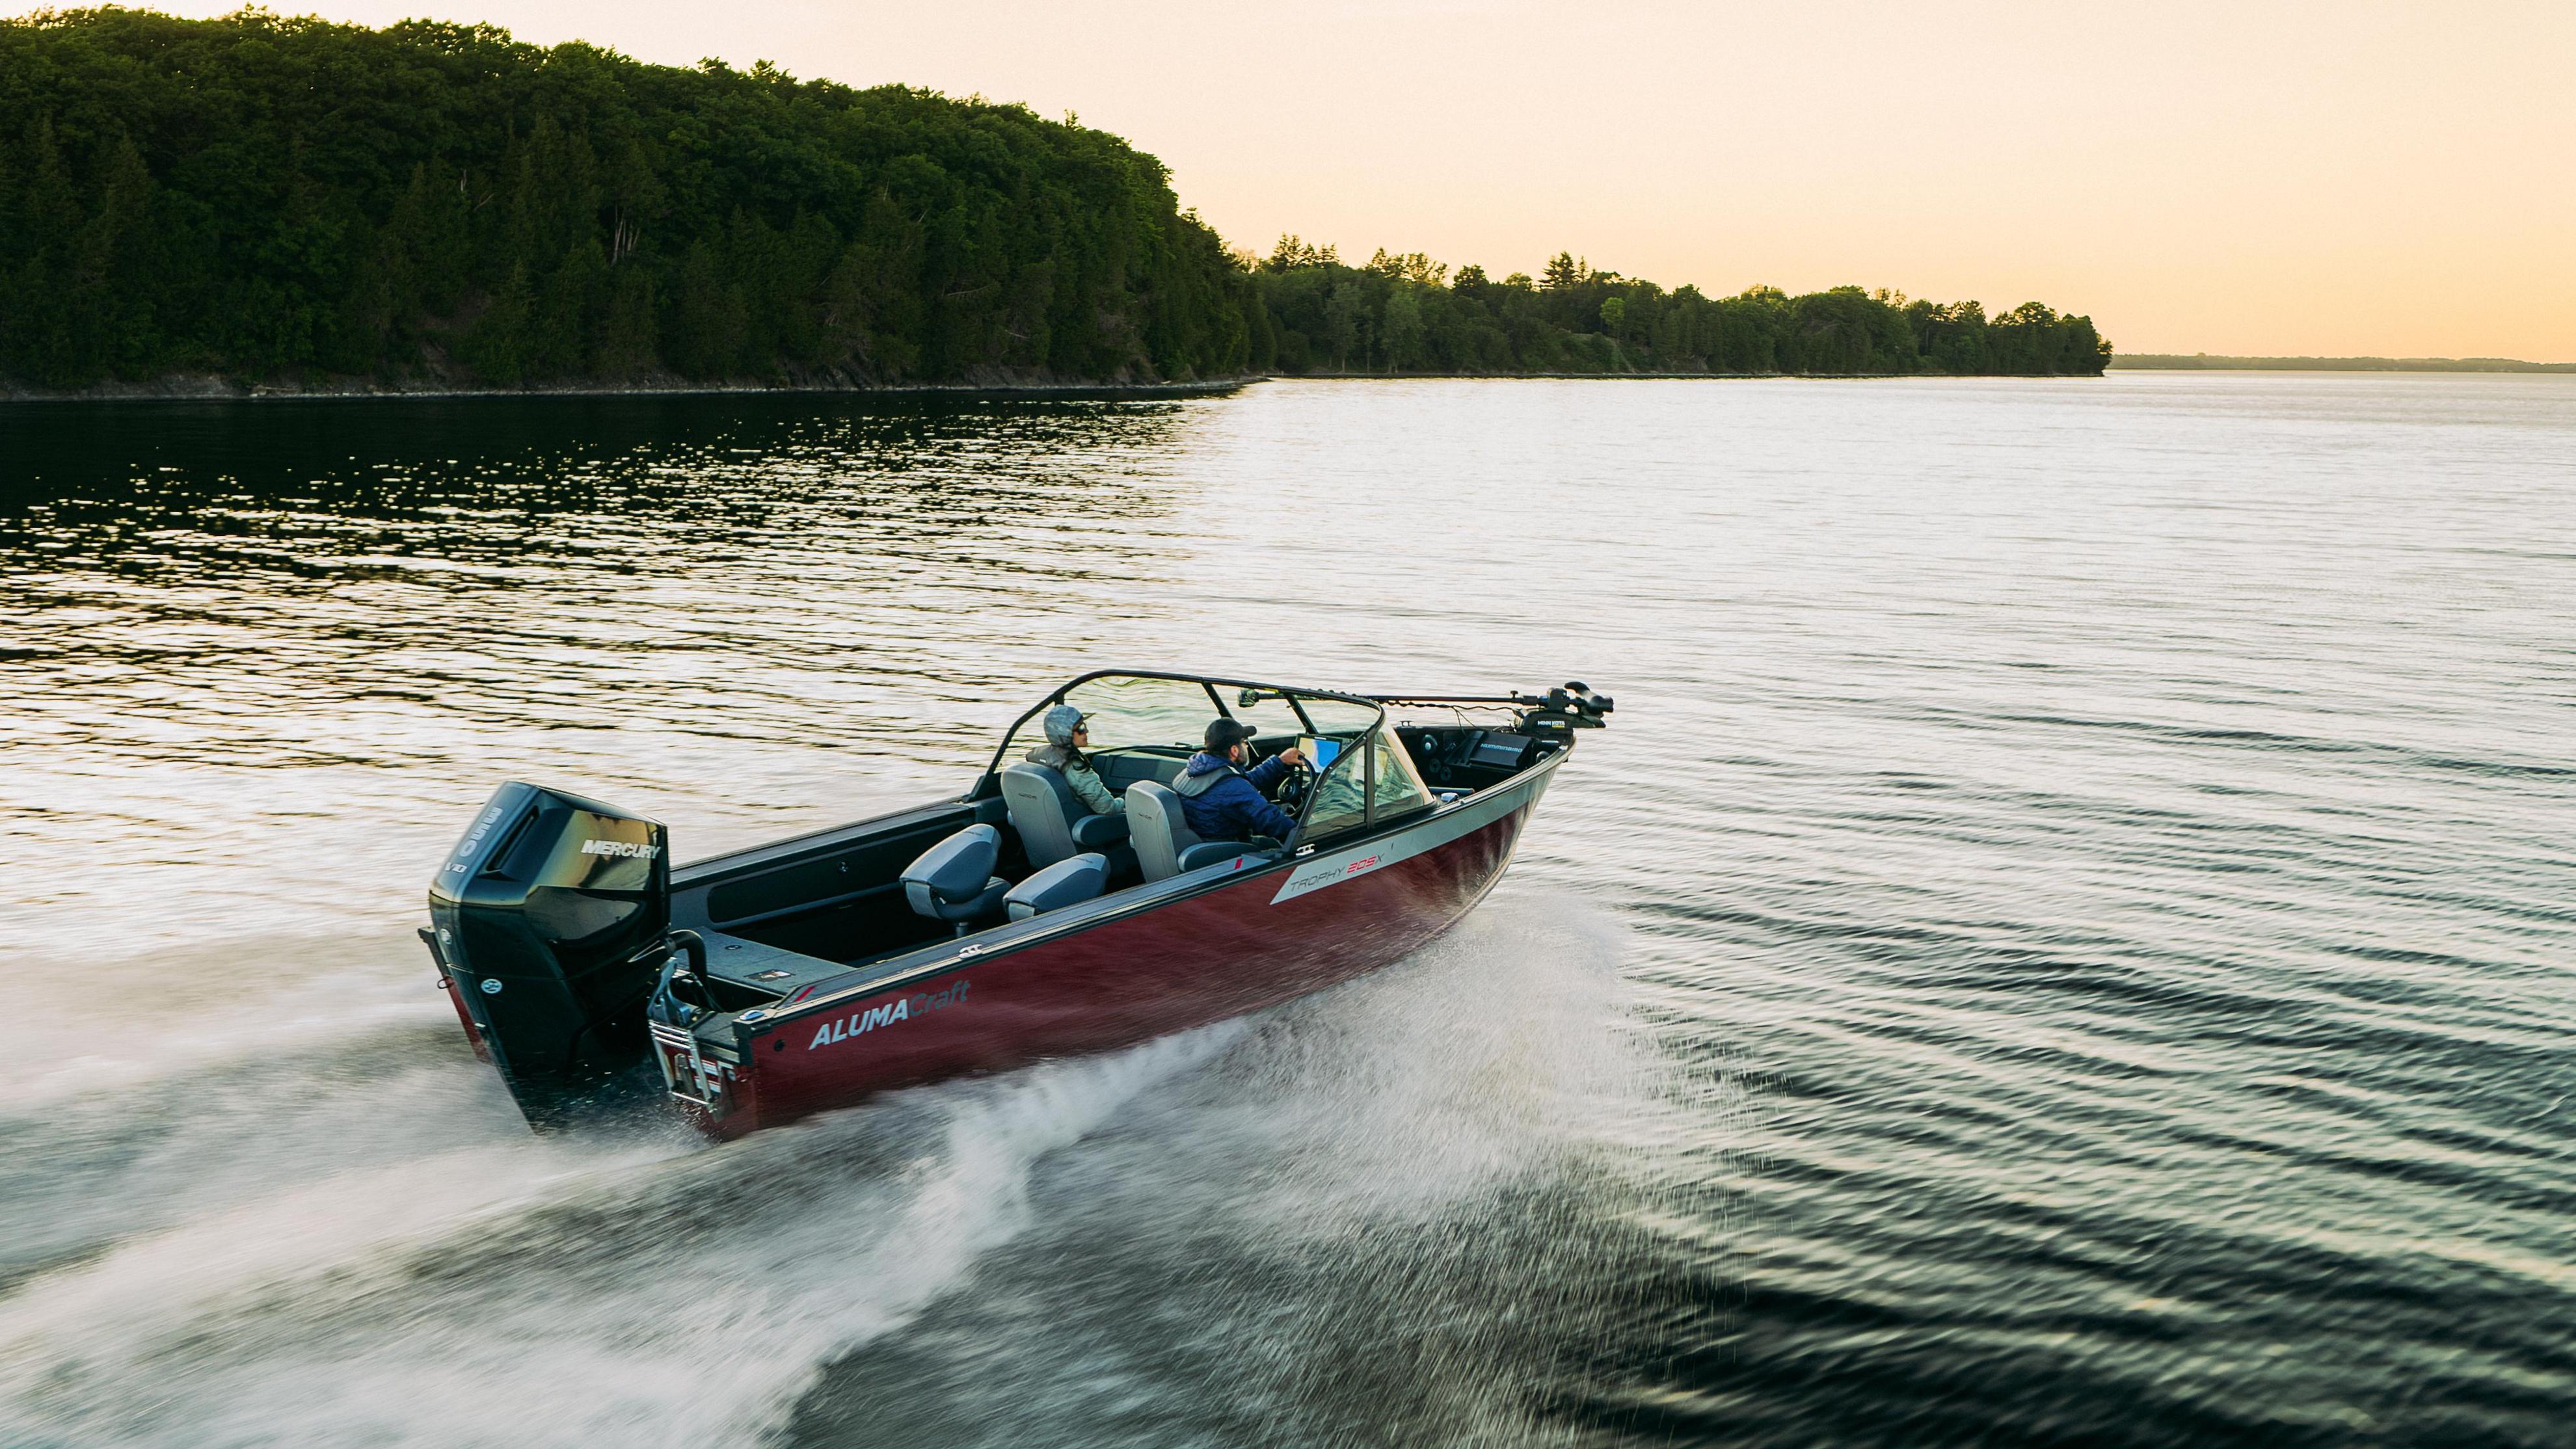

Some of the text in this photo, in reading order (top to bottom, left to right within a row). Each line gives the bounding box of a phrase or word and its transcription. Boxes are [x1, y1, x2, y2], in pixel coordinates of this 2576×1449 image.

[459, 806, 503, 857] 350
[580, 839, 661, 859] MERCURY
[1291, 866, 1345, 892] TROPHY
